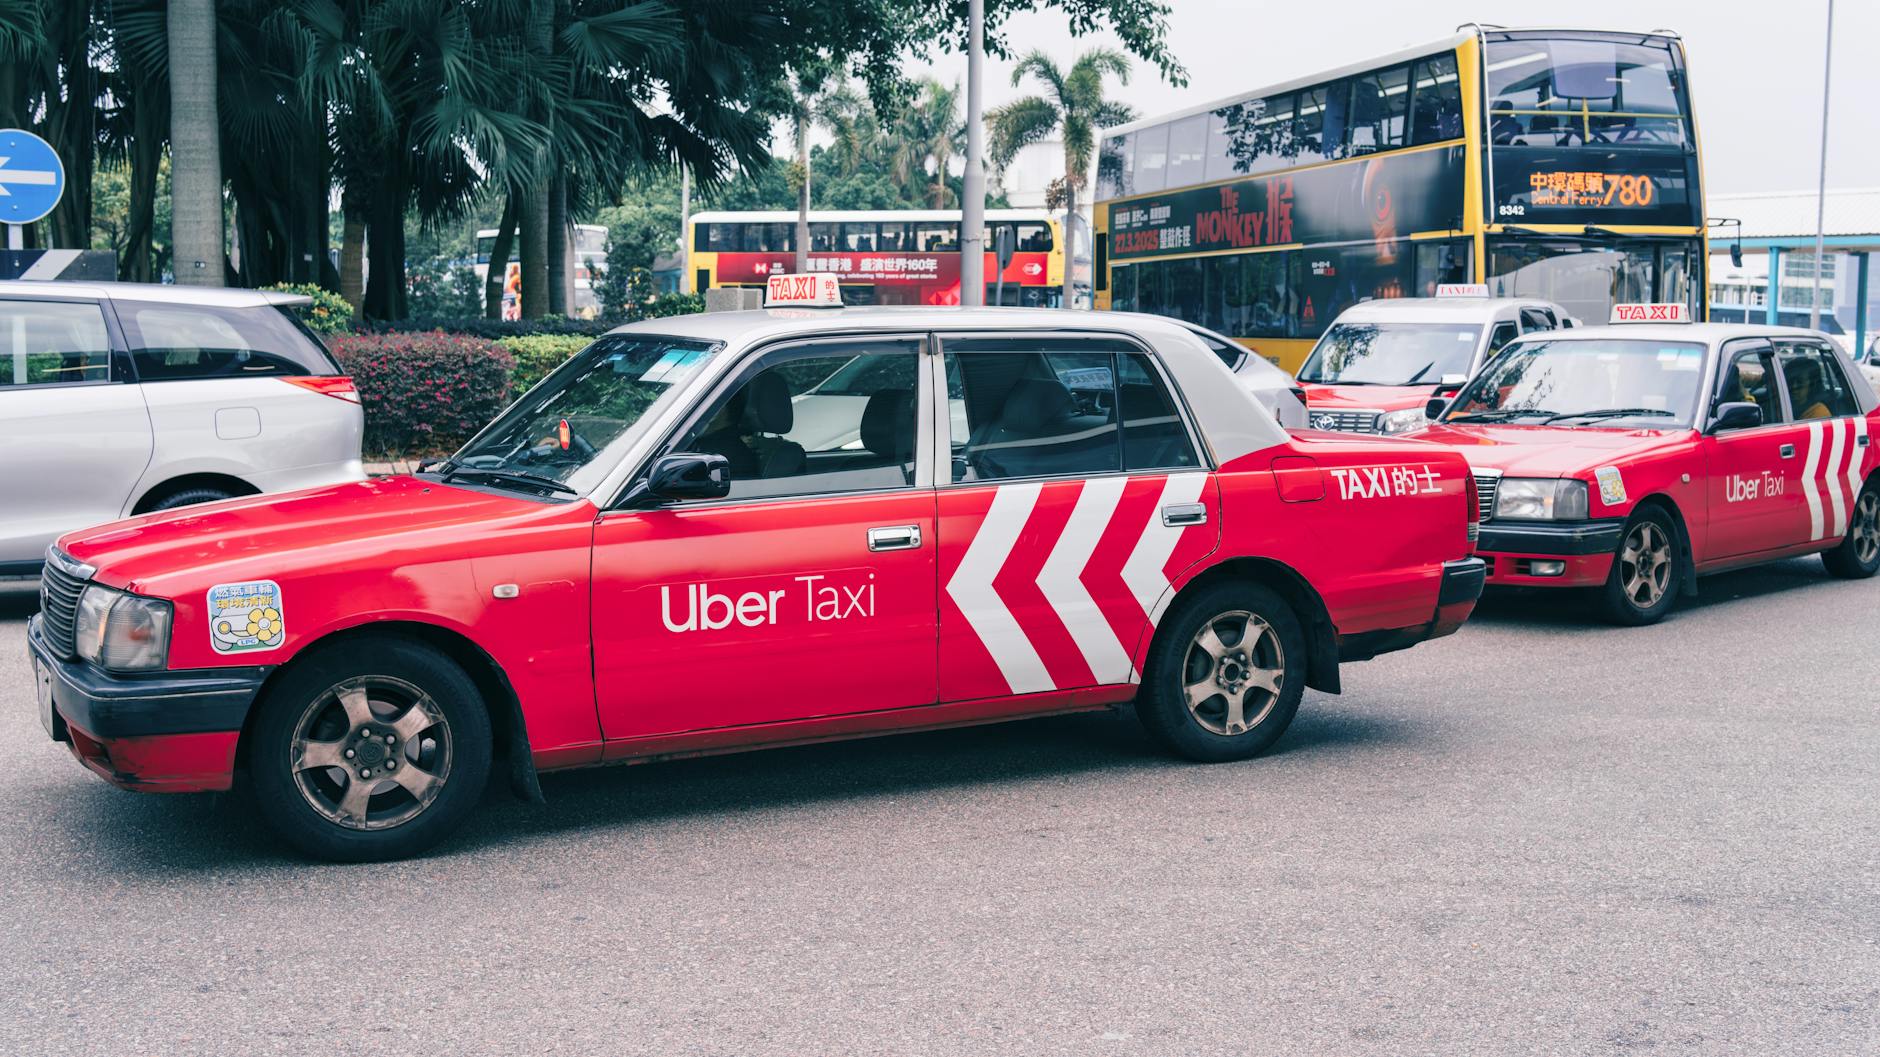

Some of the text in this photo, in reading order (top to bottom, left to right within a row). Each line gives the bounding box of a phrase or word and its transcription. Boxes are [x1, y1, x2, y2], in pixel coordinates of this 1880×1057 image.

[1530, 172, 1604, 193] 中環碼頭
[1603, 174, 1652, 206] 780
[1220, 186, 1239, 213] THE
[1499, 205, 1525, 216] 8342
[1530, 191, 1603, 207] Central Ferry
[1195, 210, 1264, 247] MONKEY
[1115, 229, 1159, 254] 27.3.2025
[770, 276, 816, 300] TAXI
[824, 280, 836, 302] 的士
[1616, 305, 1679, 320] TAXI
[1725, 470, 1785, 503] Uber Taxi
[661, 573, 875, 633] Uber Taxi
